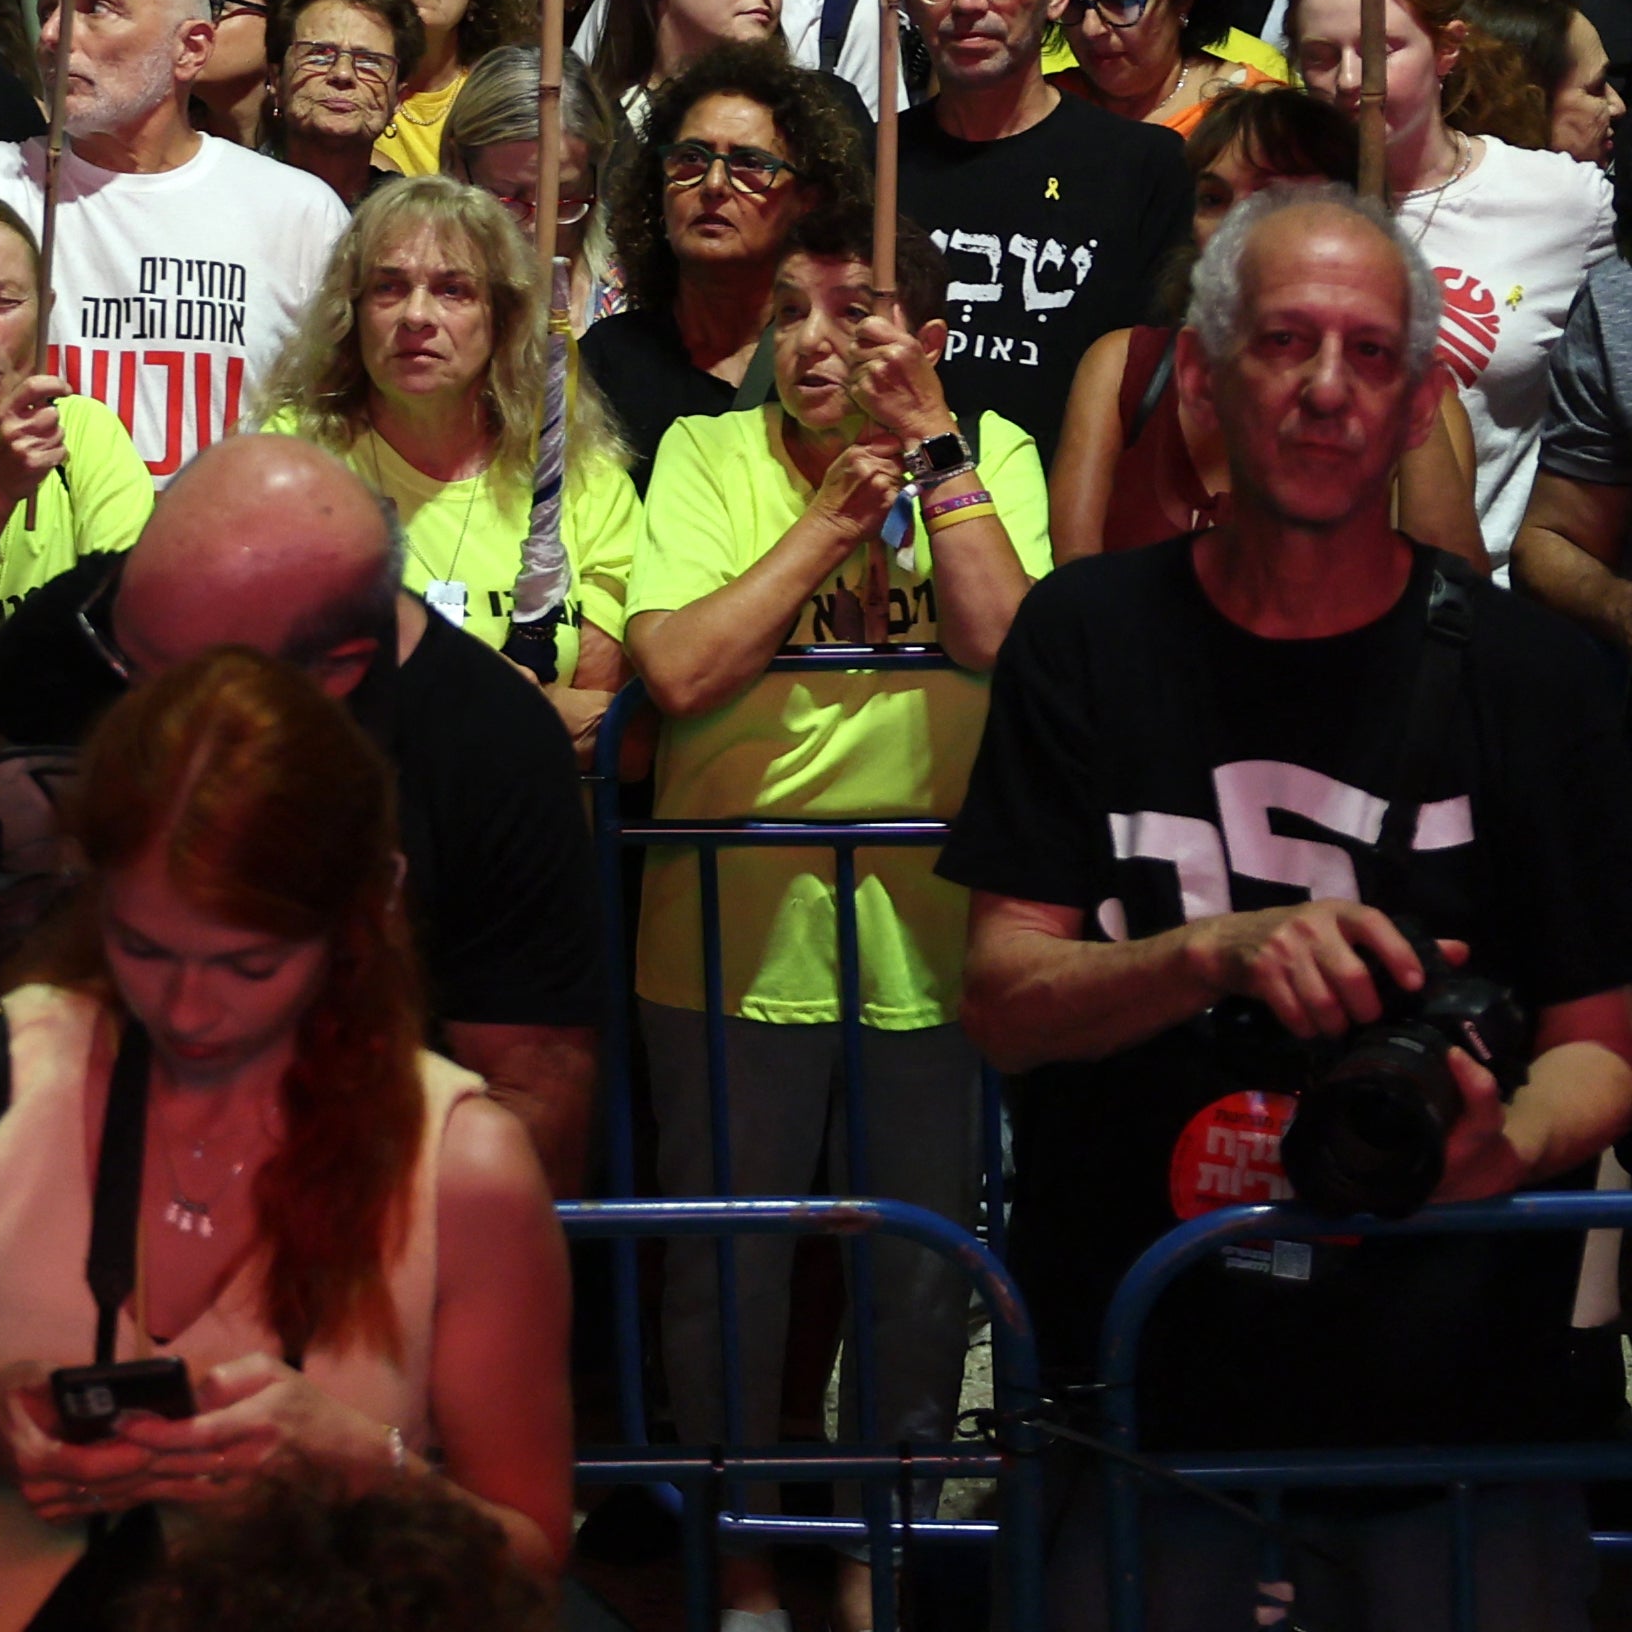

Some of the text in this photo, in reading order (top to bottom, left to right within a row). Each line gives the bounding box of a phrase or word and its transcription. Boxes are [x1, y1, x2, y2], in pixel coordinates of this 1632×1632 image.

[140, 257, 246, 302] מחזירים
[82, 297, 246, 346] אותם הביתה
